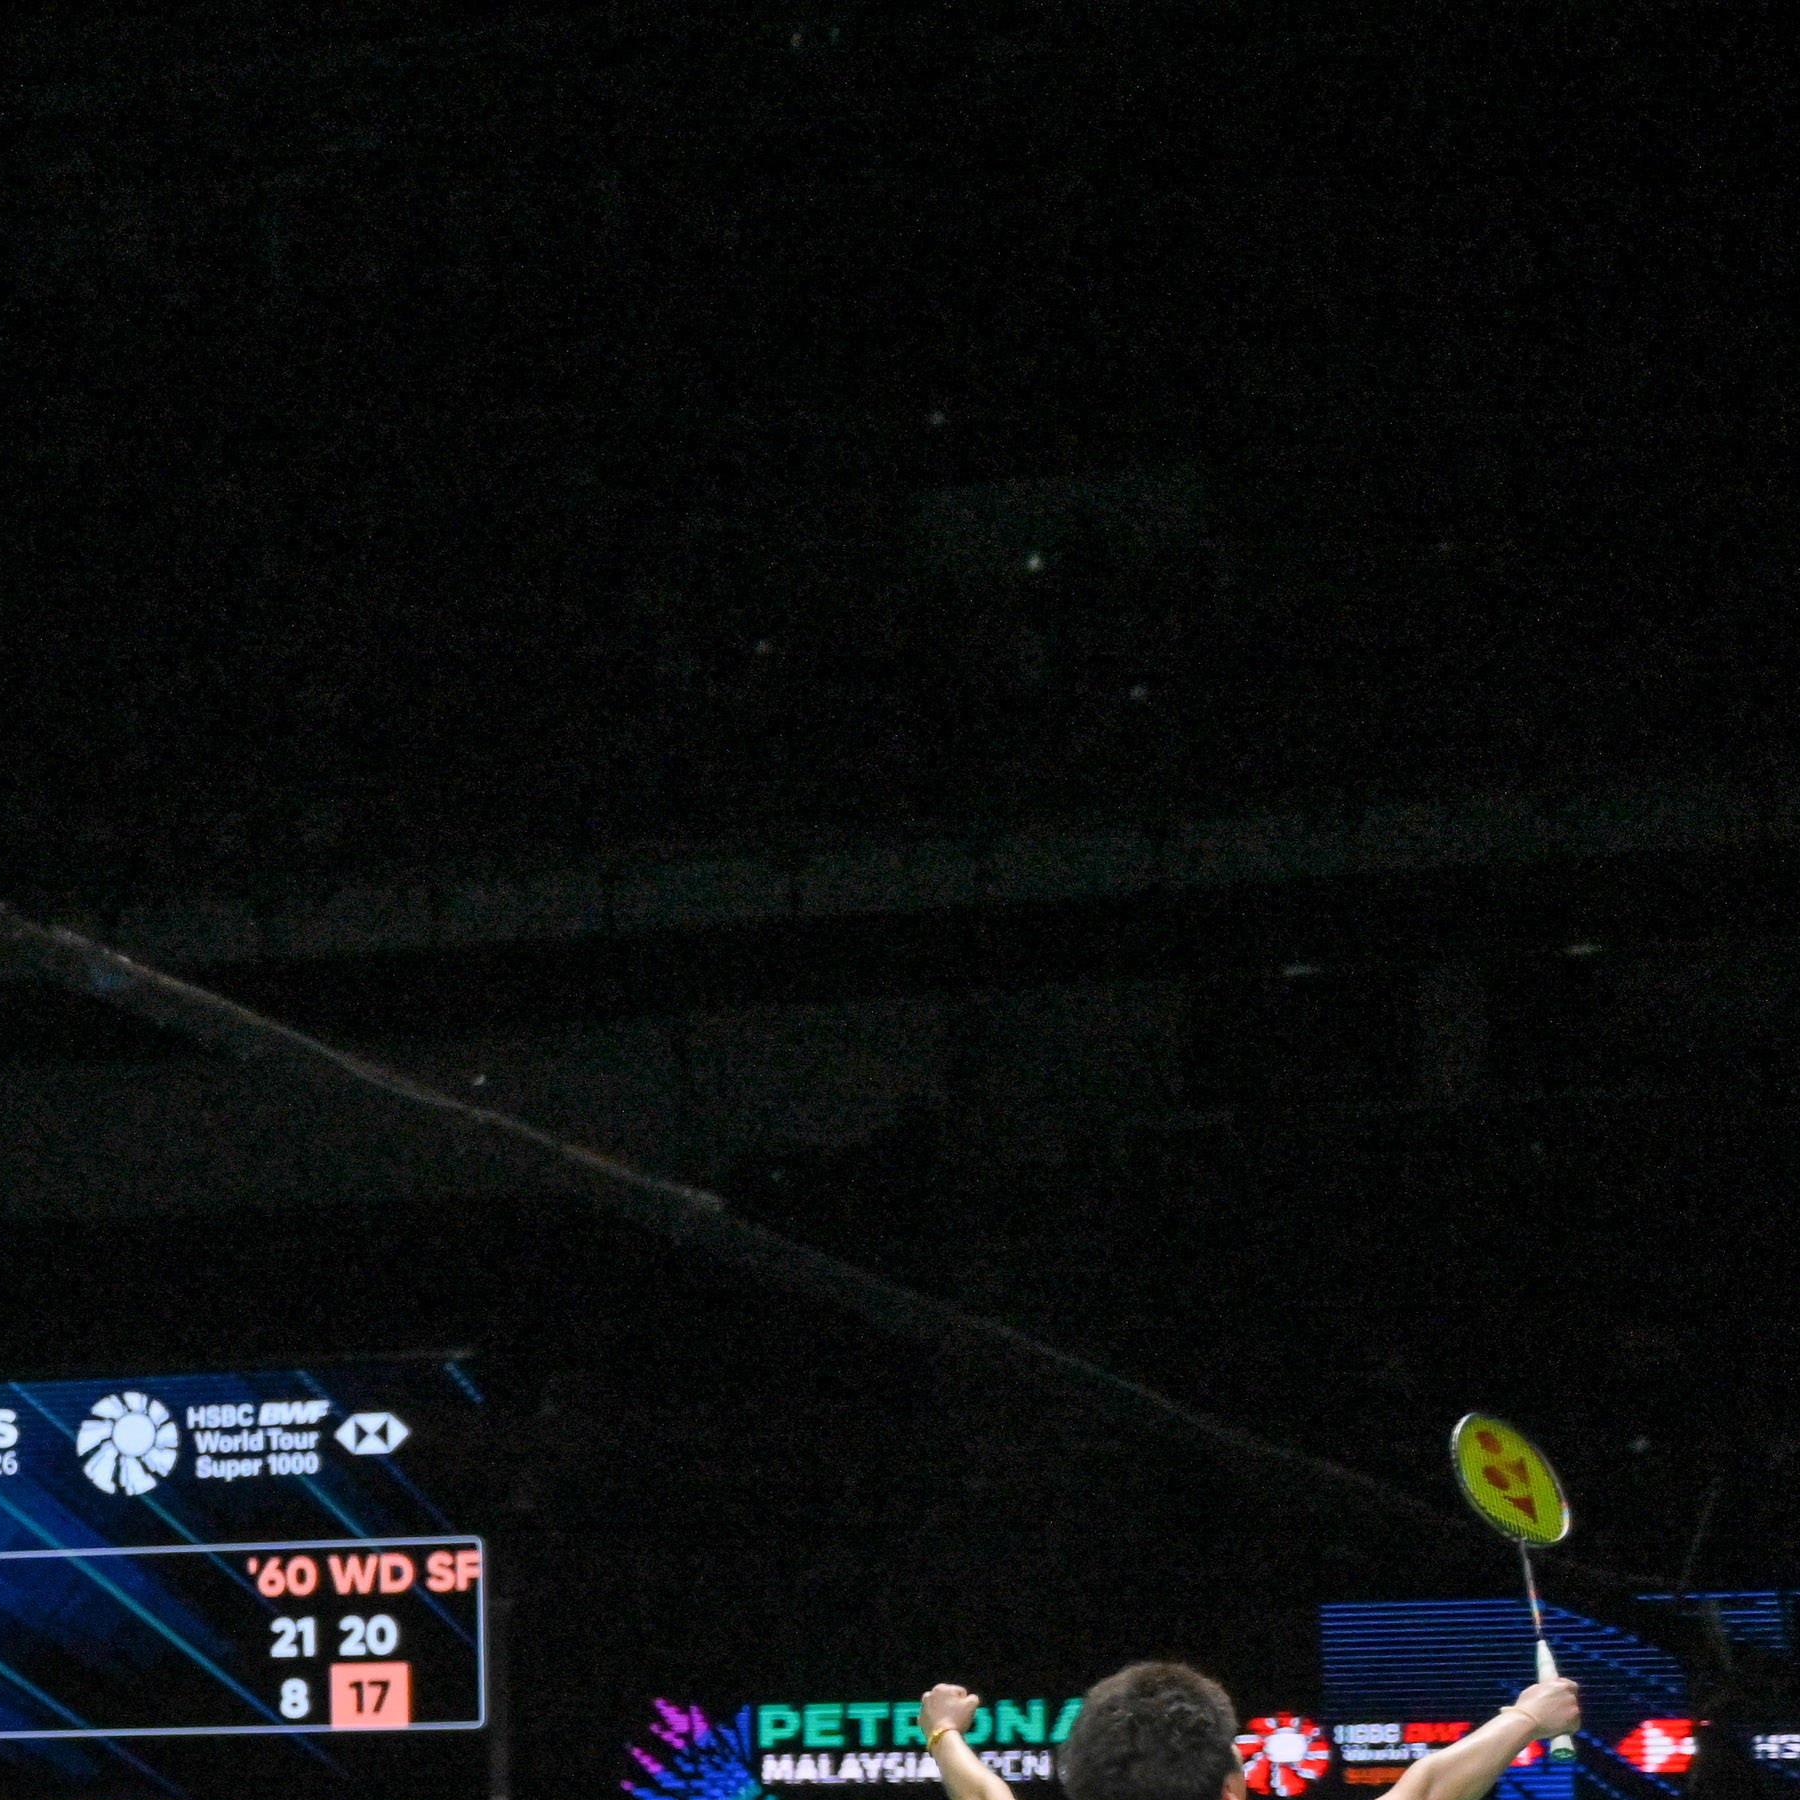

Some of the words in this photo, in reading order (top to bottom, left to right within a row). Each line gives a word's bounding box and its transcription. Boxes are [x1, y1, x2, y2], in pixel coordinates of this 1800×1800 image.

[187, 1404, 254, 1429] HSBC
[259, 1401, 329, 1427] BWF
[194, 1429, 263, 1453] World
[266, 1427, 319, 1451] Tour
[196, 1454, 262, 1481] Super
[267, 1451, 319, 1476] 1000
[247, 1555, 318, 1597] '60
[328, 1553, 415, 1595] WD
[426, 1551, 480, 1592] SF
[270, 1616, 316, 1657] 21
[339, 1614, 397, 1656] 20
[280, 1677, 308, 1719] 8
[348, 1681, 390, 1714] 17
[758, 1698, 1082, 1748] PETRN
[761, 1752, 943, 1784] MALAYSIA
